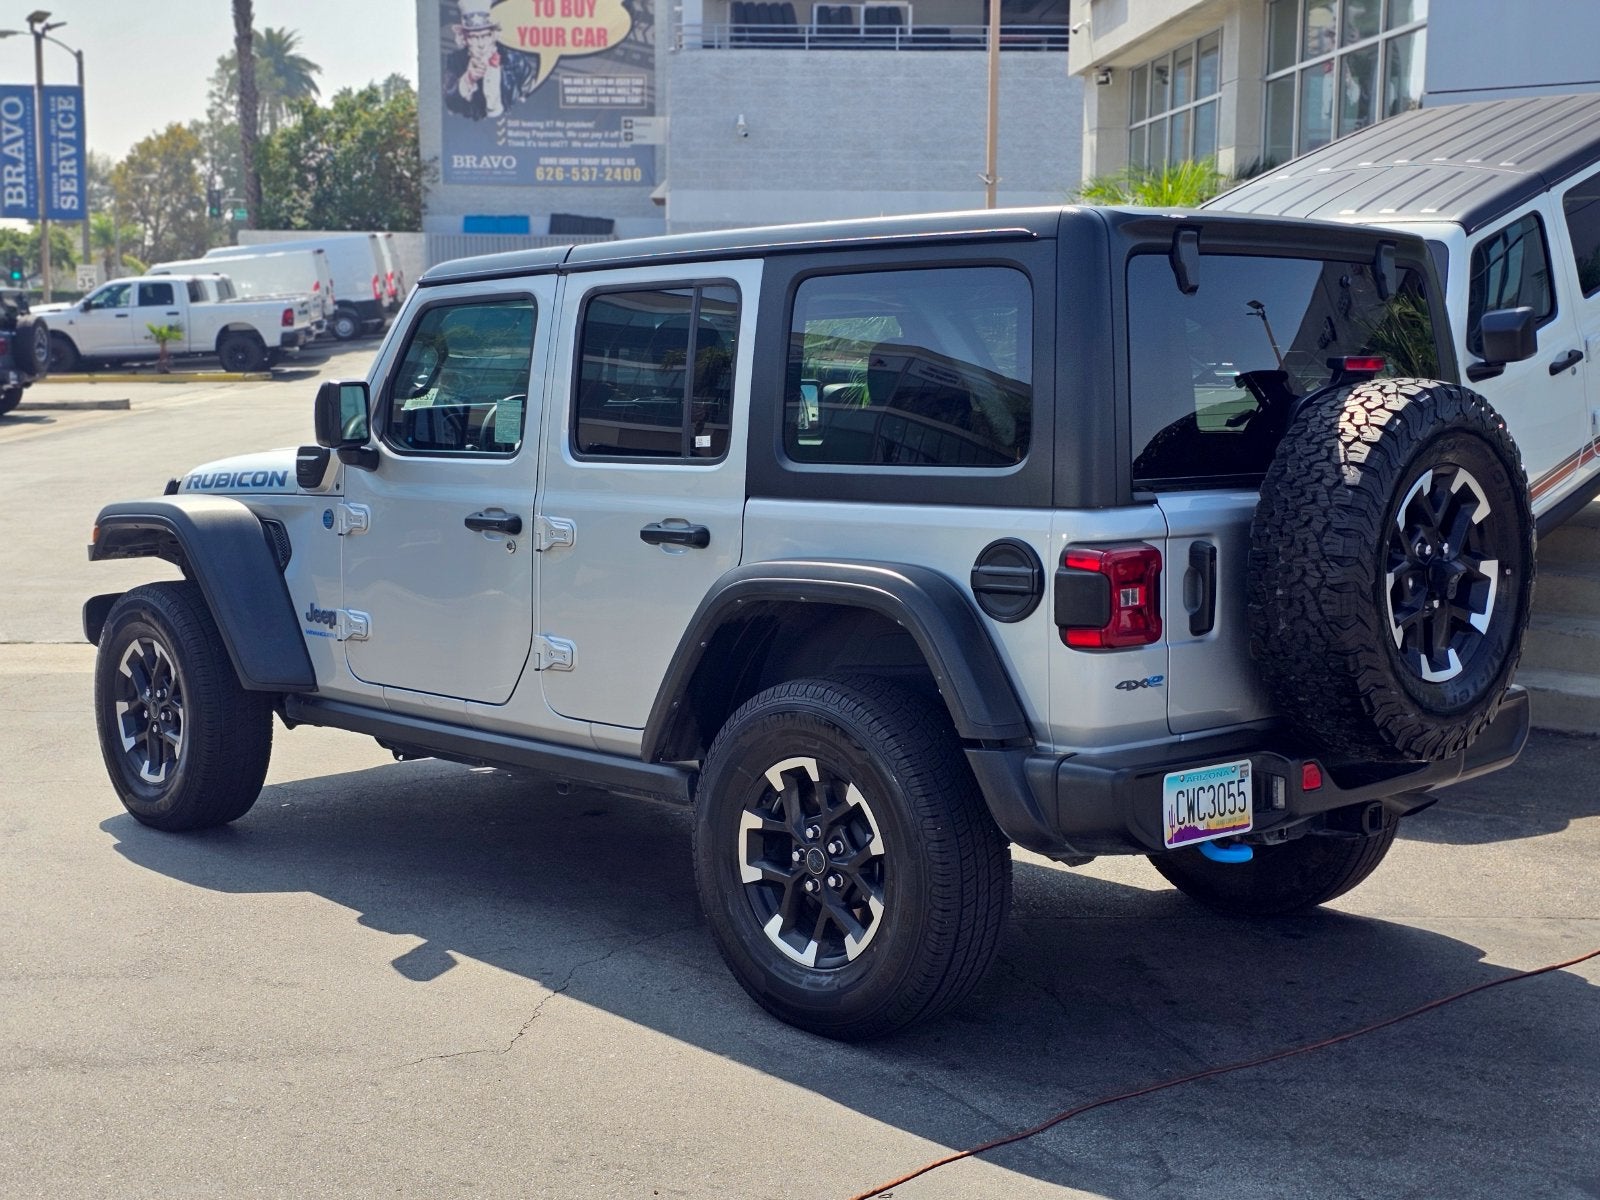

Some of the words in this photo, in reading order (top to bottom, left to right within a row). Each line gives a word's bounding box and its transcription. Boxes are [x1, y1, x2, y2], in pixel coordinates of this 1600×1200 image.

[532, 0, 556, 18] TO
[560, 0, 596, 18] BUY
[517, 26, 567, 48] YOUR
[571, 26, 608, 48] CAR
[0, 96, 27, 208] BRAVO
[56, 95, 79, 210] SERVICE
[452, 155, 517, 169] BRAVO
[536, 166, 642, 181] 626-537-2400
[79, 278, 96, 289] 35
[185, 470, 289, 489] RUBICON
[305, 602, 337, 629] Jeep
[1186, 769, 1230, 783] ARIZONA
[1176, 778, 1247, 825] CWC3055
